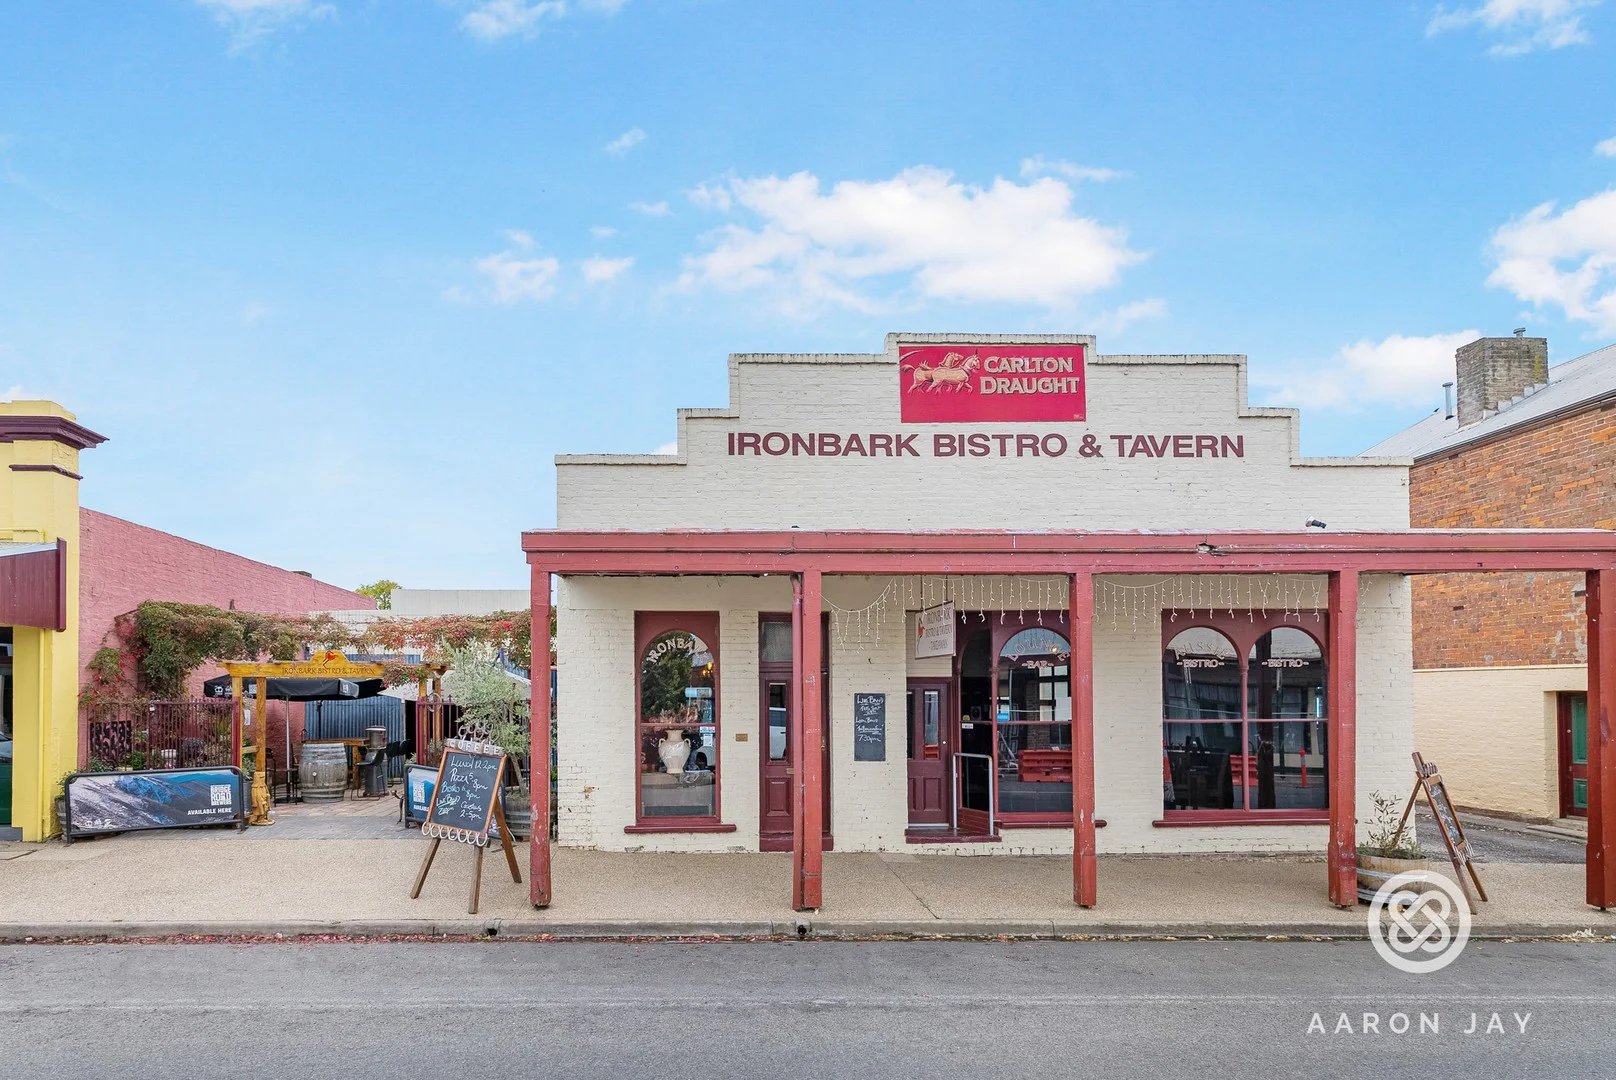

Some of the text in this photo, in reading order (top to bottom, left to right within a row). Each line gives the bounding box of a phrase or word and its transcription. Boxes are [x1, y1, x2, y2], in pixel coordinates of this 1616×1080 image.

[984, 356, 1074, 373] CARLTON
[980, 376, 1080, 395] DRAUGHT
[728, 432, 1245, 458] IRONBARK BISTRO & TAVERN
[449, 741, 500, 755] COFFEE
